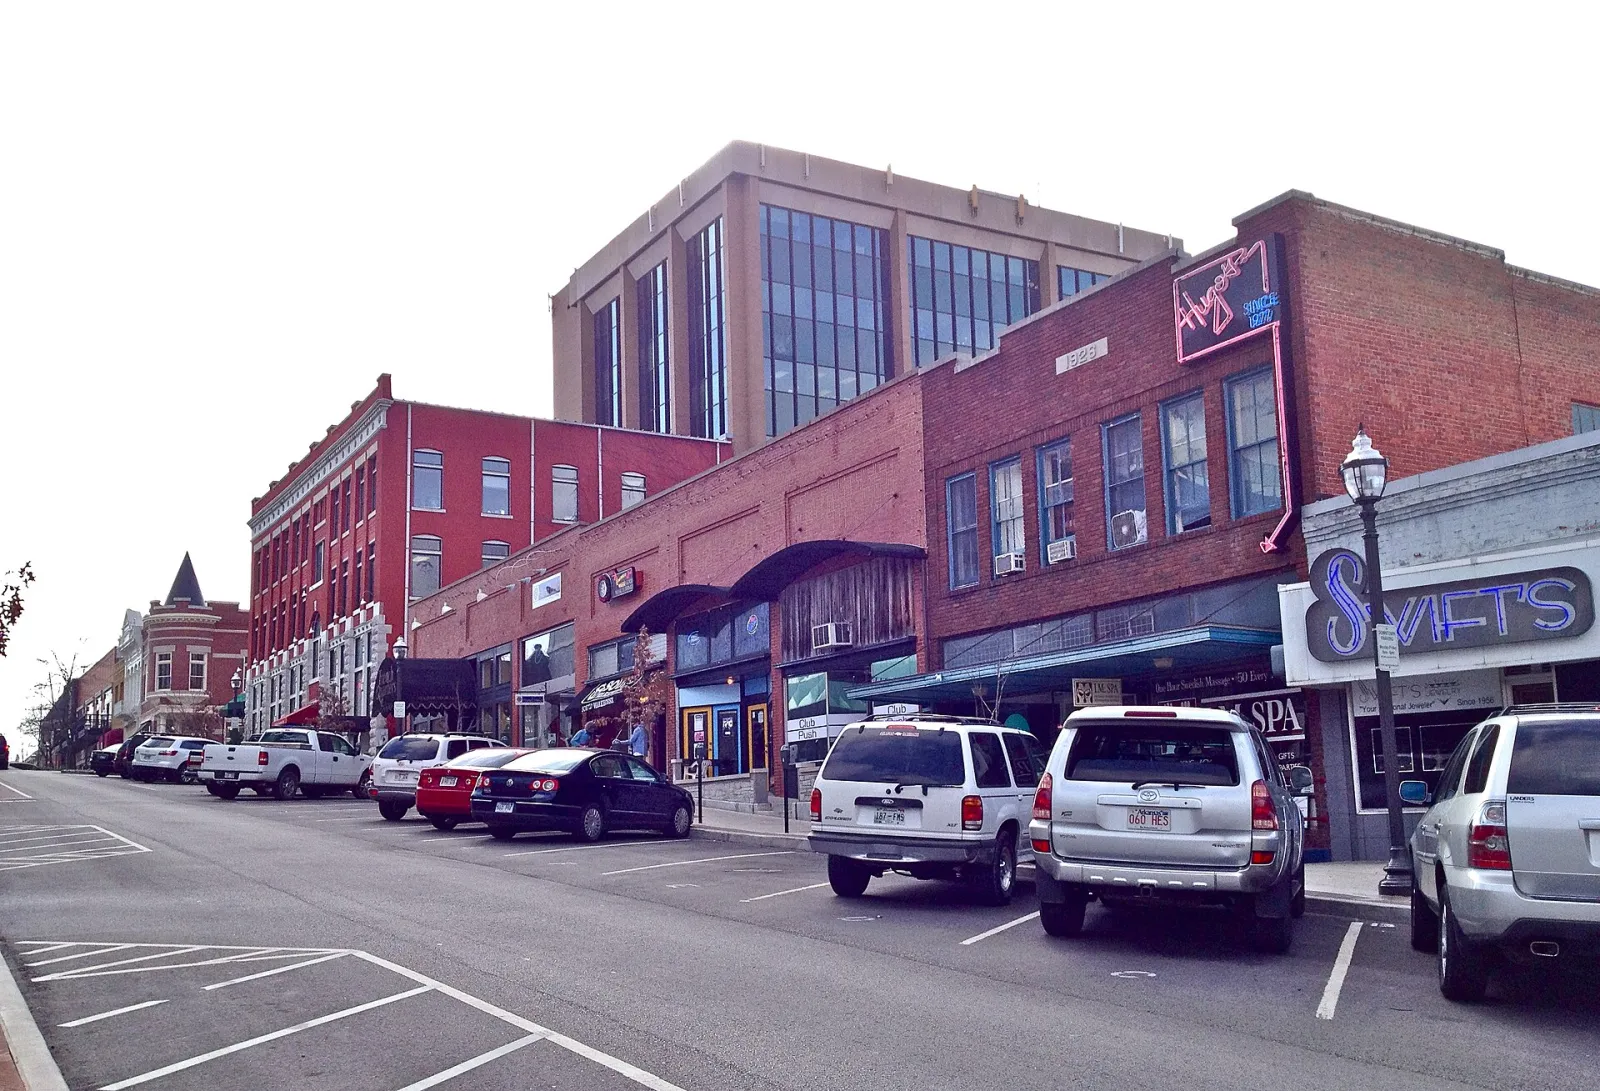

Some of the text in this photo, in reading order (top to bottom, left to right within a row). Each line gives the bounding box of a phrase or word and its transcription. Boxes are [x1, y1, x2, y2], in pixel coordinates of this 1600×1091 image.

[1243, 291, 1281, 316] SINCE
[1205, 675, 1231, 687] Massage
[1249, 670, 1268, 682] Every
[1457, 698, 1476, 707] Since
[888, 704, 907, 715] Club
[1251, 697, 1303, 733] SPA
[799, 718, 816, 729] Club
[798, 730, 817, 740] Push
[1278, 751, 1295, 760] GIFTS
[1128, 814, 1169, 827] 060 HES
